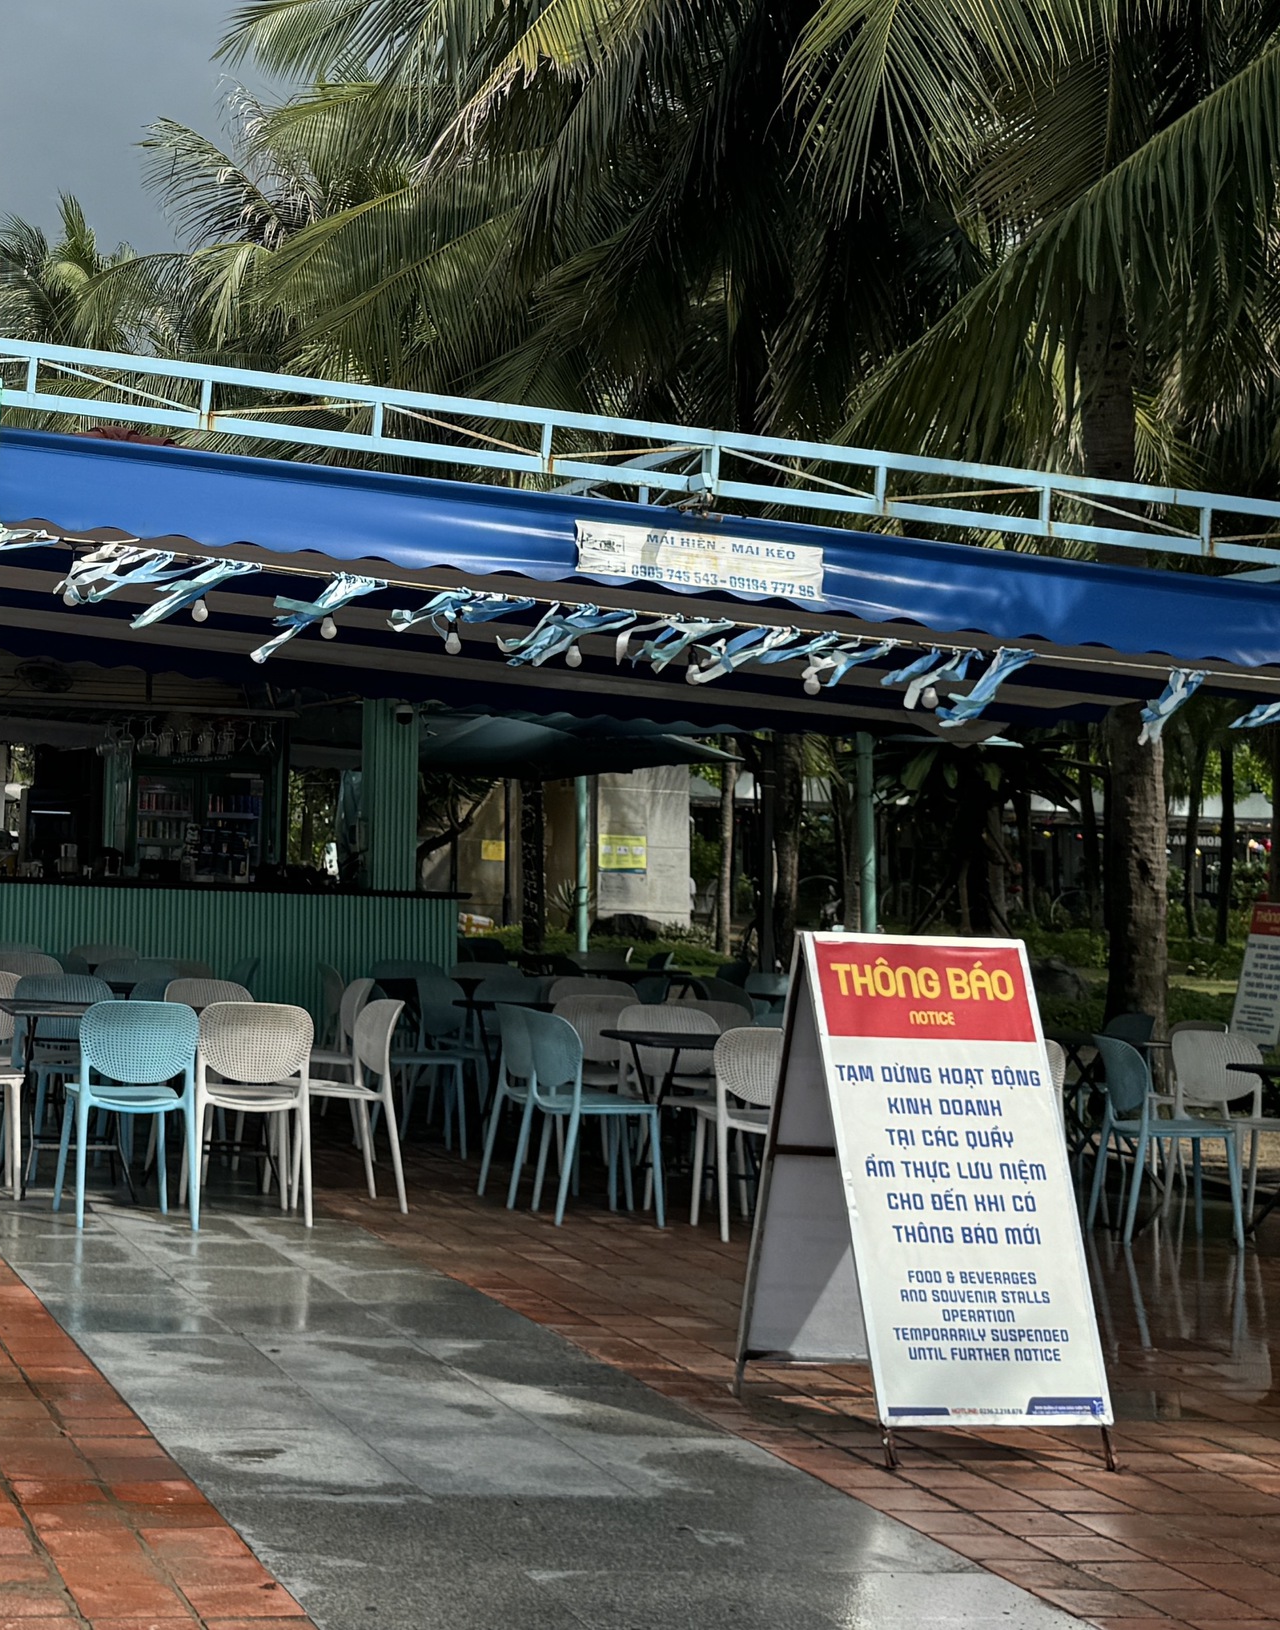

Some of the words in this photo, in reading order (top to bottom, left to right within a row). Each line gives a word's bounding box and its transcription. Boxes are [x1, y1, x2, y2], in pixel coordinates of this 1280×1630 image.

[667, 568, 691, 582] 745
[771, 581, 794, 595] 777
[830, 957, 940, 1000] THÔNG
[946, 961, 1015, 1001] BÁO
[910, 1011, 956, 1026] NOTICE
[836, 1065, 875, 1086] TẠM
[882, 1063, 932, 1084] DỪNG
[939, 1068, 984, 1089] HOẠT
[992, 1066, 1041, 1090] ĐỘNG
[888, 1098, 932, 1115] KINH
[940, 1100, 1002, 1116] DOANH
[886, 1129, 915, 1150] TẠI
[922, 1127, 959, 1147] CÁC
[966, 1126, 1014, 1149] QUẦY
[865, 1154, 896, 1178] ẨM
[901, 1161, 951, 1183] THỰC
[957, 1162, 993, 1180] LƯU
[1001, 1160, 1047, 1184] NIỆM
[887, 1193, 924, 1210] CHO
[932, 1188, 968, 1211] ĐẾN
[974, 1194, 1006, 1212] KHI
[1013, 1192, 1037, 1213] CÓ
[893, 1222, 954, 1244] THÔNG
[961, 1224, 998, 1245] BÁO
[1005, 1225, 1042, 1245] MỚI
[908, 1270, 942, 1284] FOOD
[947, 1271, 955, 1284] &
[959, 1271, 1037, 1285] BEVERAGES
[901, 1290, 927, 1303] AND
[932, 1290, 997, 1304] SOUVENIR
[1002, 1291, 1051, 1304] STALLS
[942, 1309, 1016, 1323] OPERATION
[893, 1327, 987, 1342] TEMPORARILY
[991, 1328, 1069, 1343] SUSPENDED
[909, 1347, 947, 1361] UNTIL
[951, 1348, 1011, 1362] FURTHER
[1015, 1349, 1062, 1362] NOTICE
